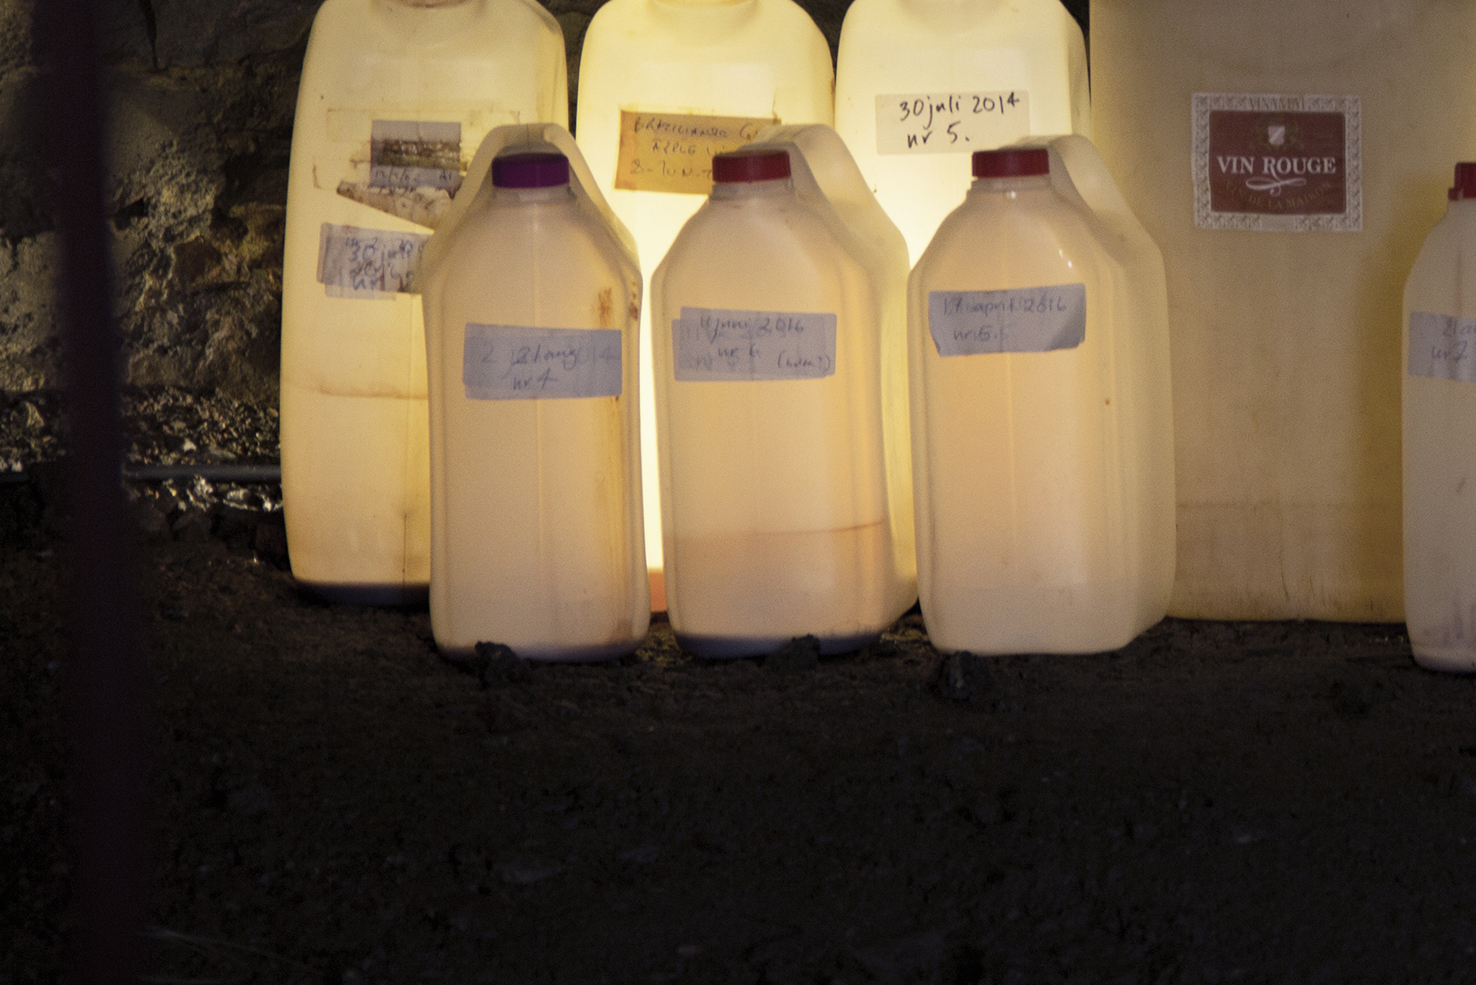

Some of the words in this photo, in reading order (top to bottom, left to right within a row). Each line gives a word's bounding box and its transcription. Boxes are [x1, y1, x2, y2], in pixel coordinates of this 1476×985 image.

[972, 91, 1020, 114] 2014
[907, 131, 933, 148] nr
[1216, 155, 1255, 175] VIN
[1262, 155, 1336, 177] ROUGE
